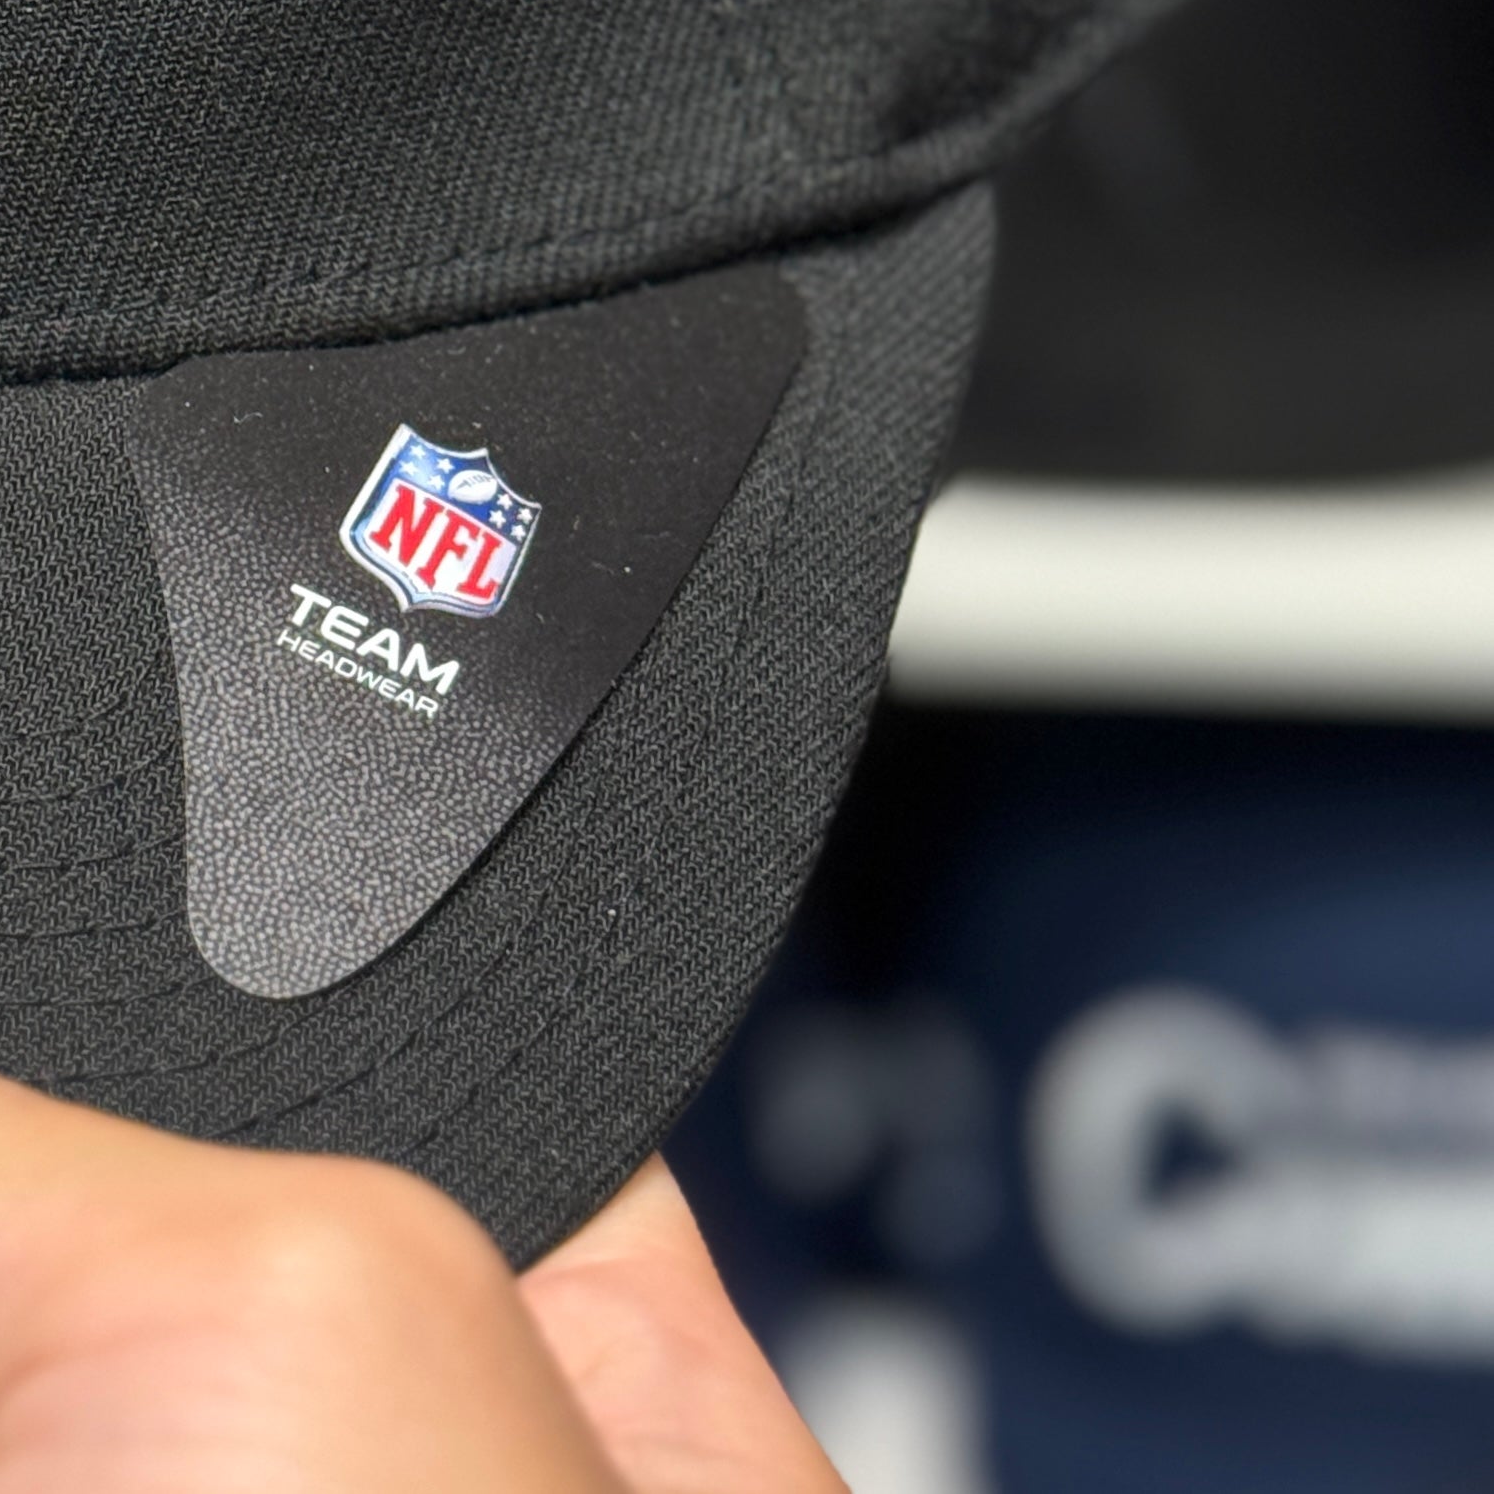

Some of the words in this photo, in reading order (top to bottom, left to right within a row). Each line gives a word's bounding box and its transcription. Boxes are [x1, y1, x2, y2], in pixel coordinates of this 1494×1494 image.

[369, 484, 503, 599] NFL
[276, 629, 440, 720] HEADWEAR
[290, 583, 460, 695] TEAM
